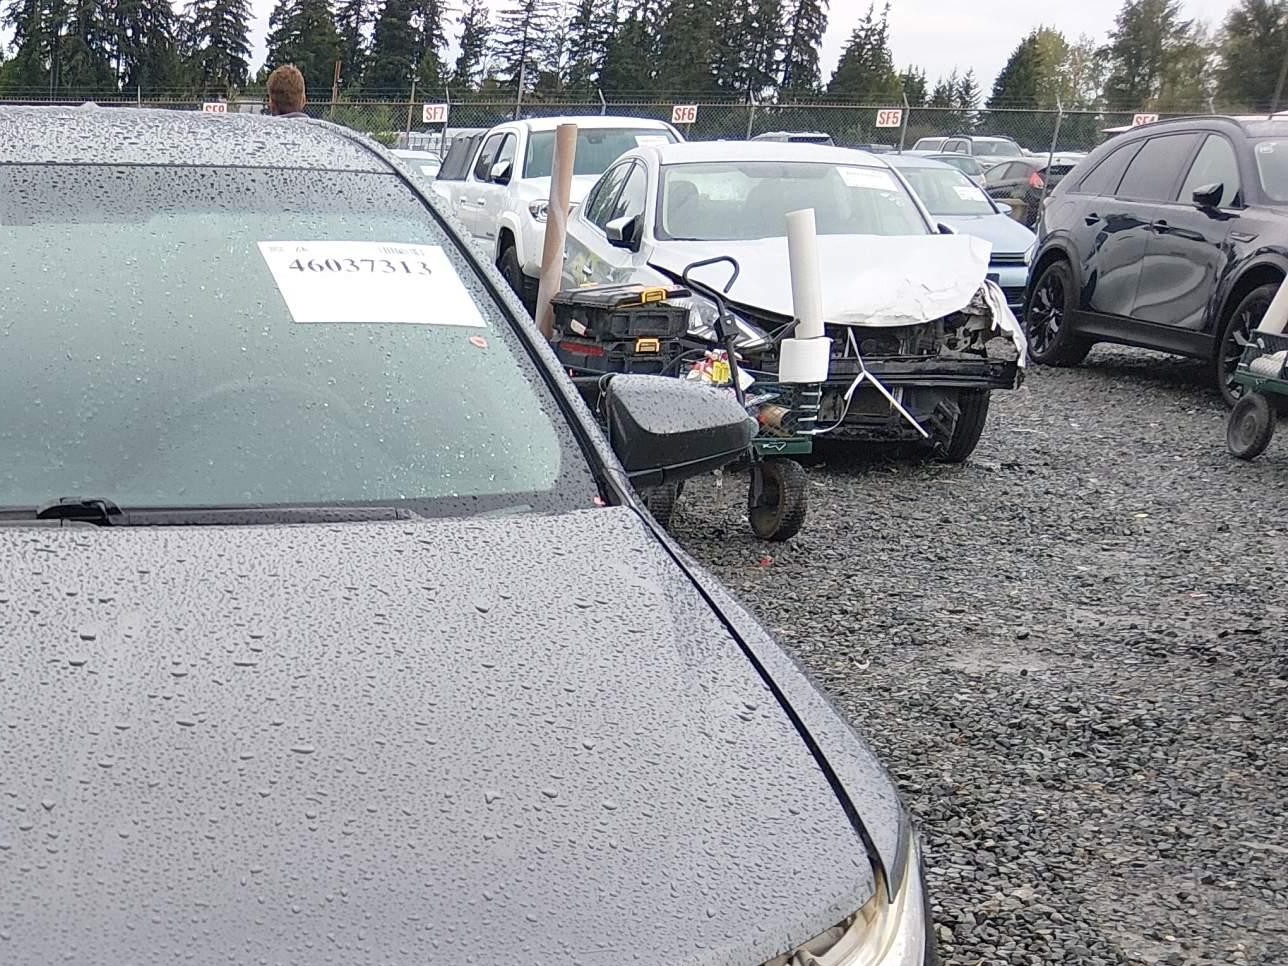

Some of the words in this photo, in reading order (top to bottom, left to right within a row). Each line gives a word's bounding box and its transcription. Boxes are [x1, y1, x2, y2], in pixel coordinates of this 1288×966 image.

[425, 106, 444, 121] SF7
[674, 107, 695, 121] SF6
[878, 111, 900, 125] SF5
[288, 257, 433, 277] 46037313
